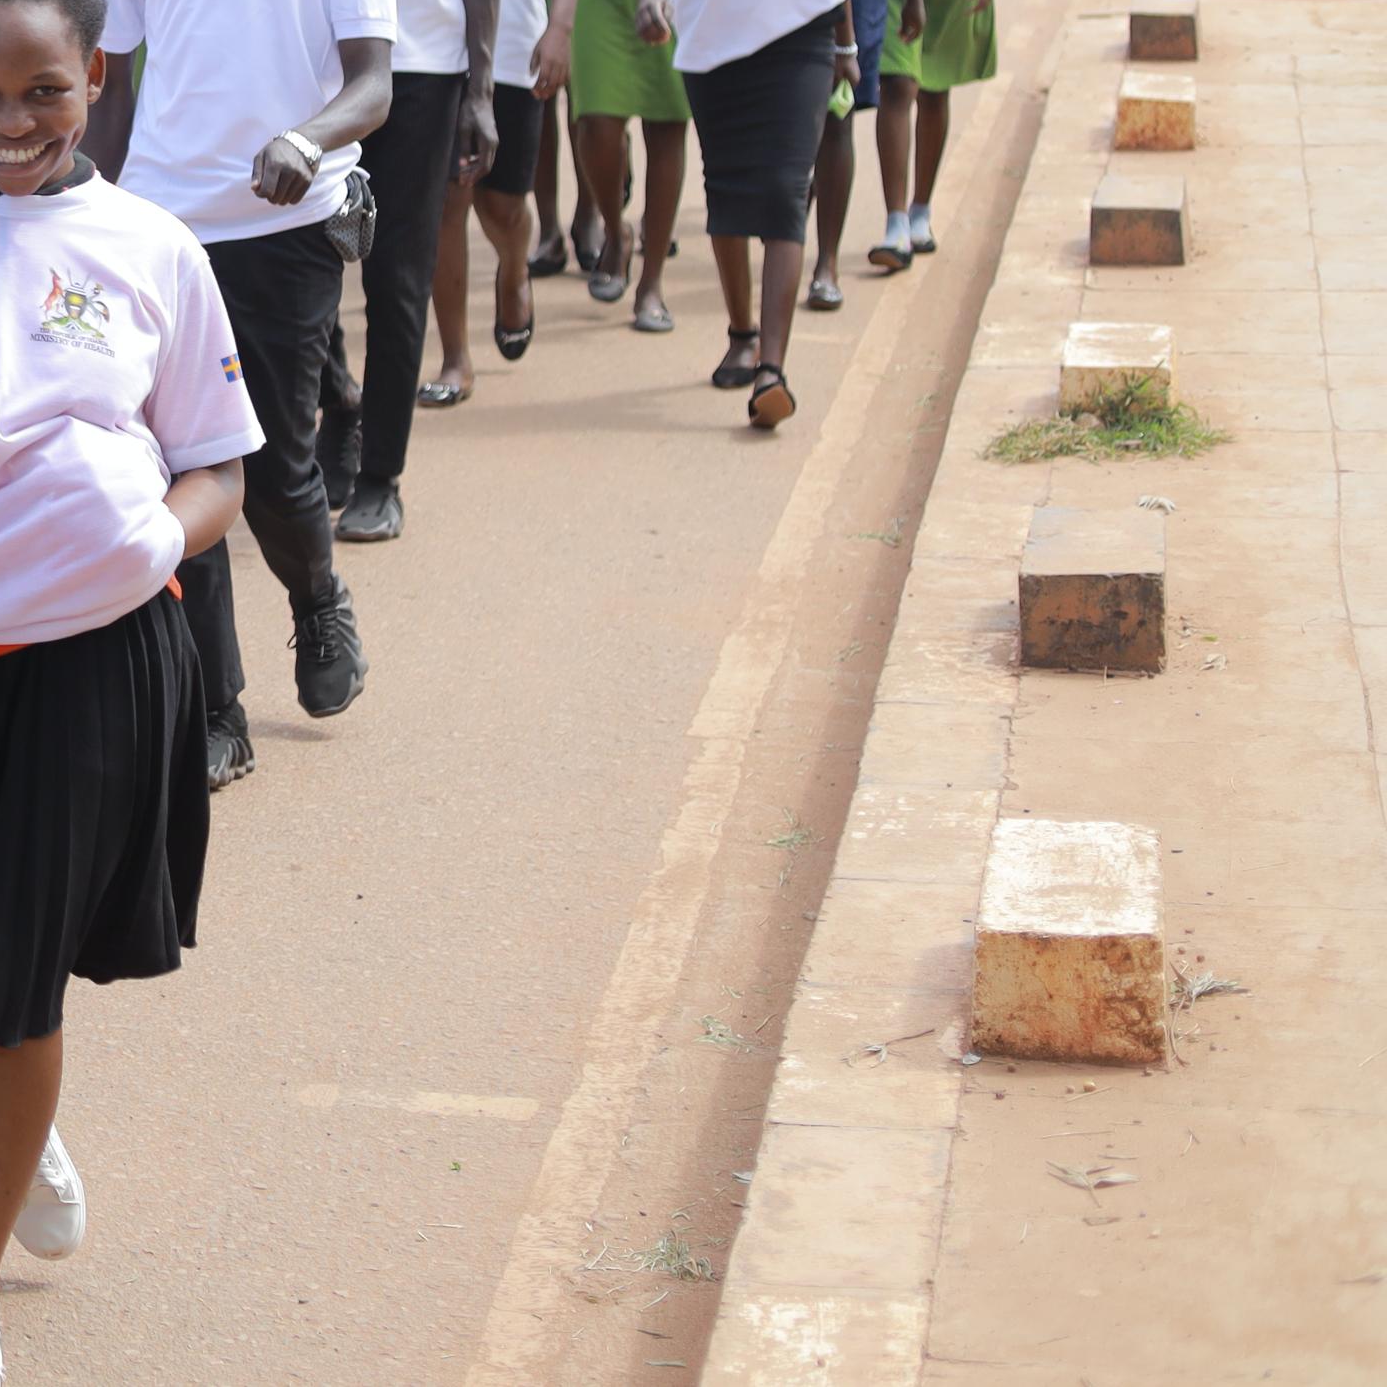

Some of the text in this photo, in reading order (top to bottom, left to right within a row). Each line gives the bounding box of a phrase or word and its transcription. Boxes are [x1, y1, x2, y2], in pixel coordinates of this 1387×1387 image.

[30, 333, 116, 359] MINISTRY OF HEALTH
